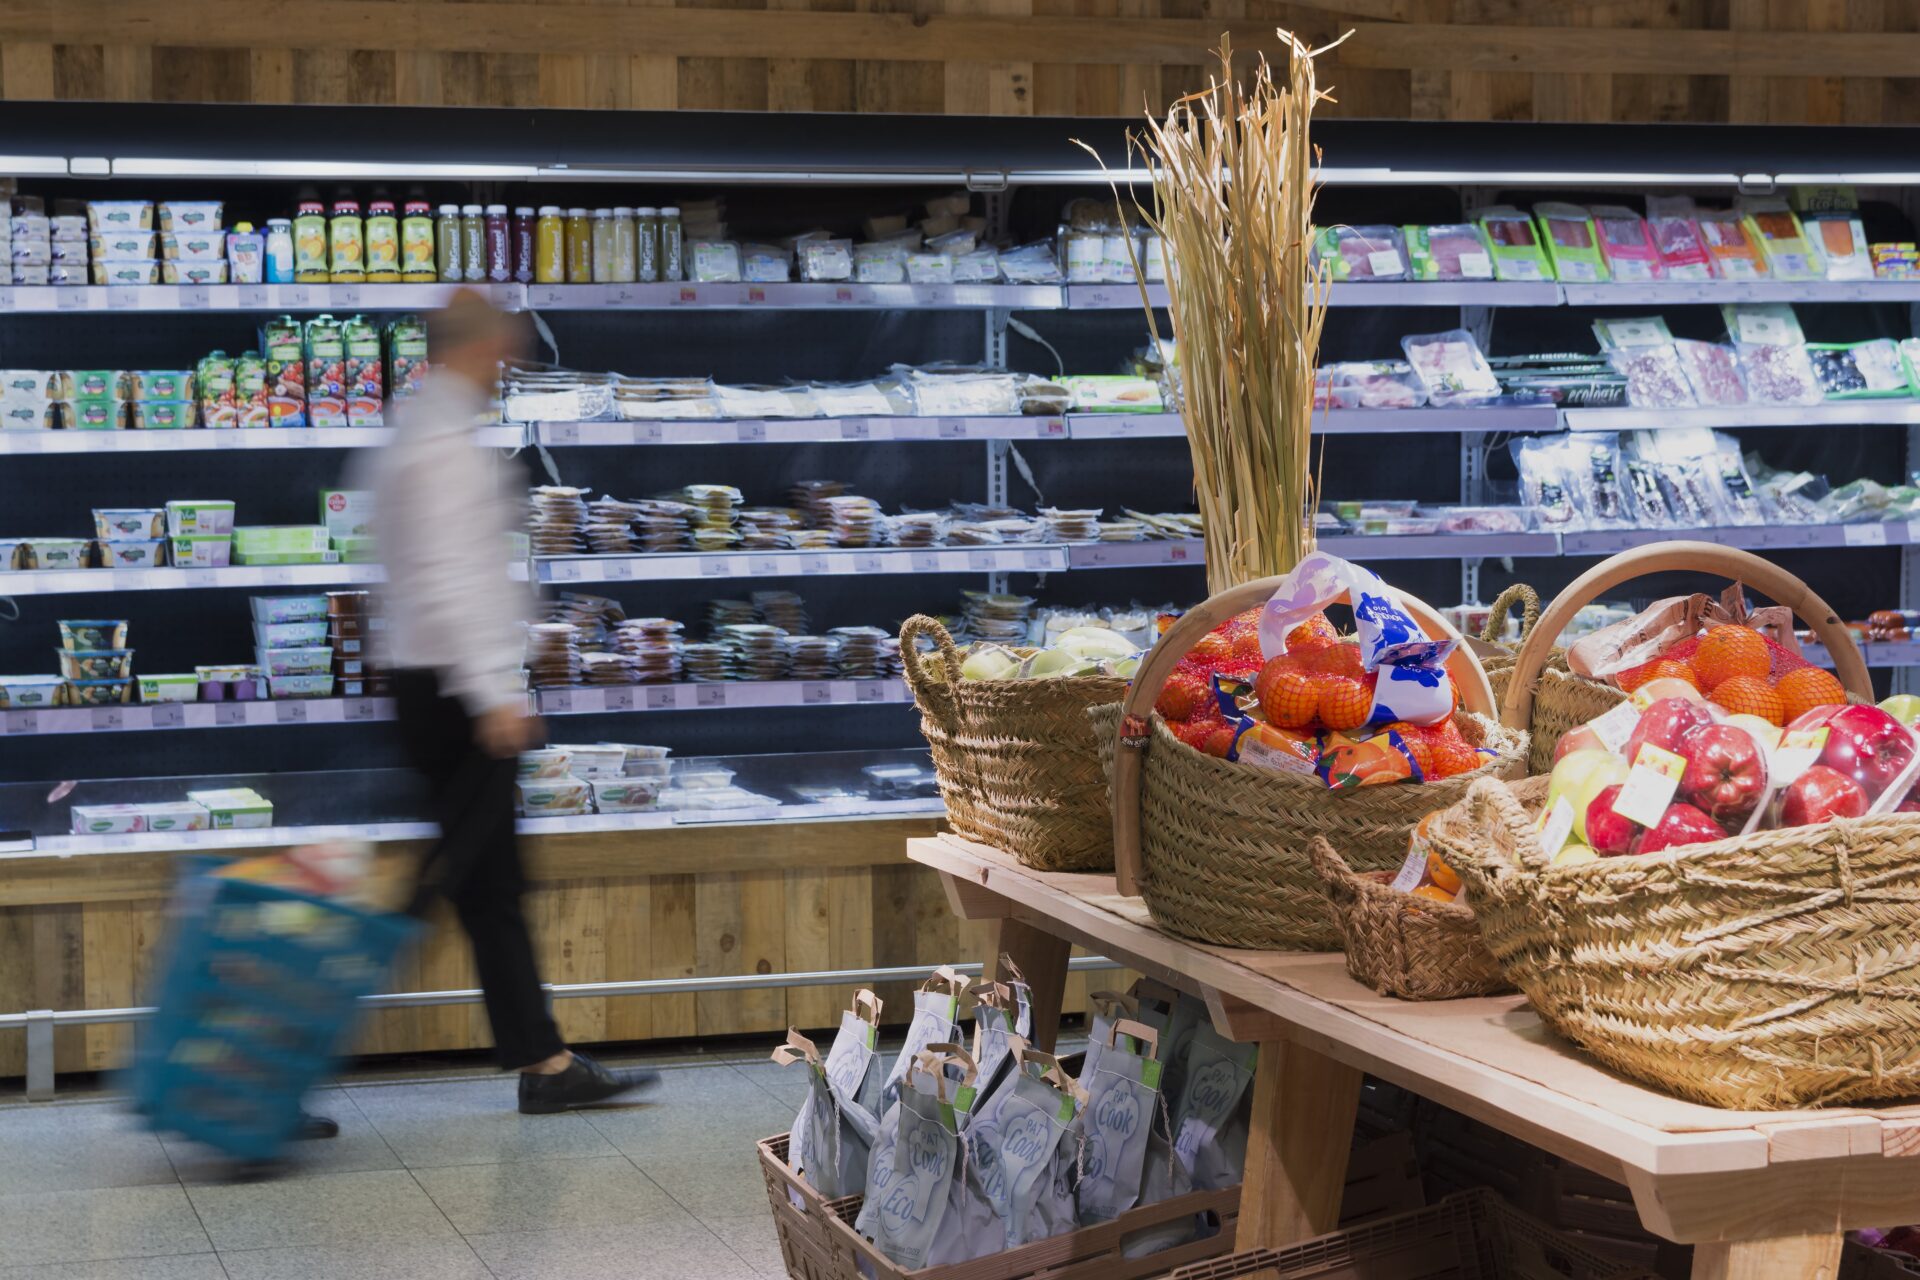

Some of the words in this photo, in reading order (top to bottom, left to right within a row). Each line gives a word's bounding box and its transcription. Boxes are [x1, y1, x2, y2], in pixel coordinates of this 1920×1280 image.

[1113, 1089, 1129, 1104] PAT
[1026, 1119, 1044, 1137] PAT
[921, 1131, 939, 1147] PAT
